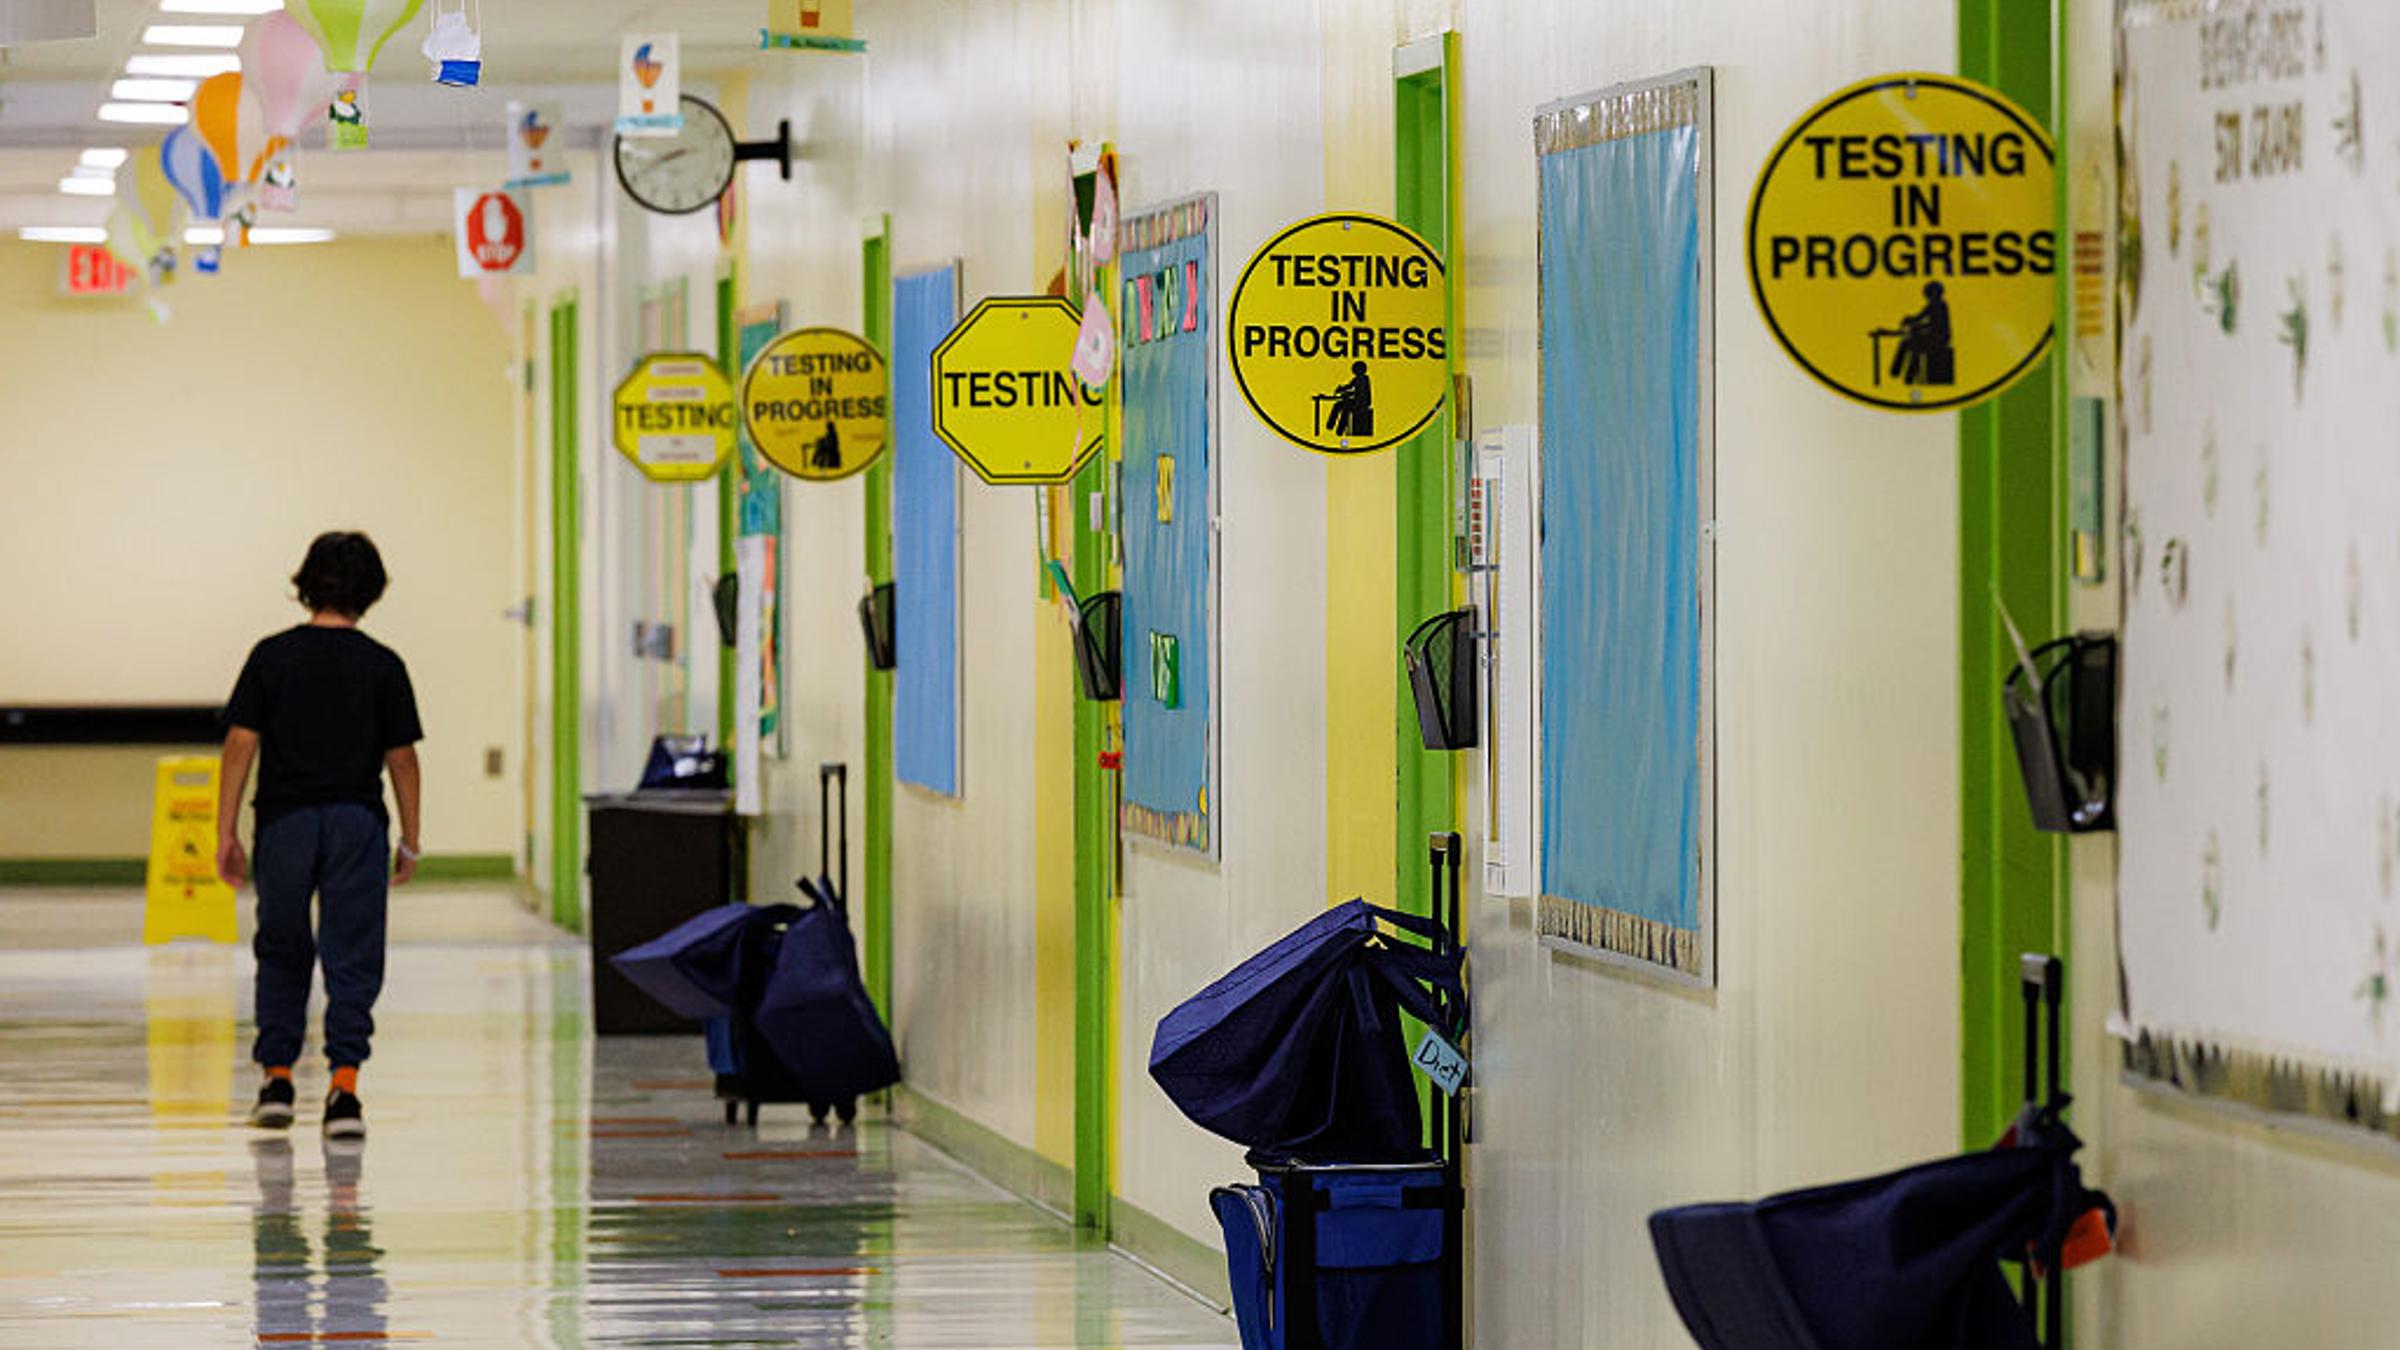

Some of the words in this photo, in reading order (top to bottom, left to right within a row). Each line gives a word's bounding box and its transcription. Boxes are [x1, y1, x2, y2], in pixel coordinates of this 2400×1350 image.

[1804, 132, 2025, 180] TESTING
[1893, 184, 1940, 228] IN
[69, 244, 138, 293] EXI
[1270, 255, 1429, 288] TESTING
[1770, 230, 2056, 280] PROGRESS
[1331, 291, 1366, 322] IN
[1244, 326, 1446, 359] PROGRESS
[770, 351, 871, 376] TESTING
[810, 377, 832, 396] IN
[754, 395, 884, 421] PROGRESS
